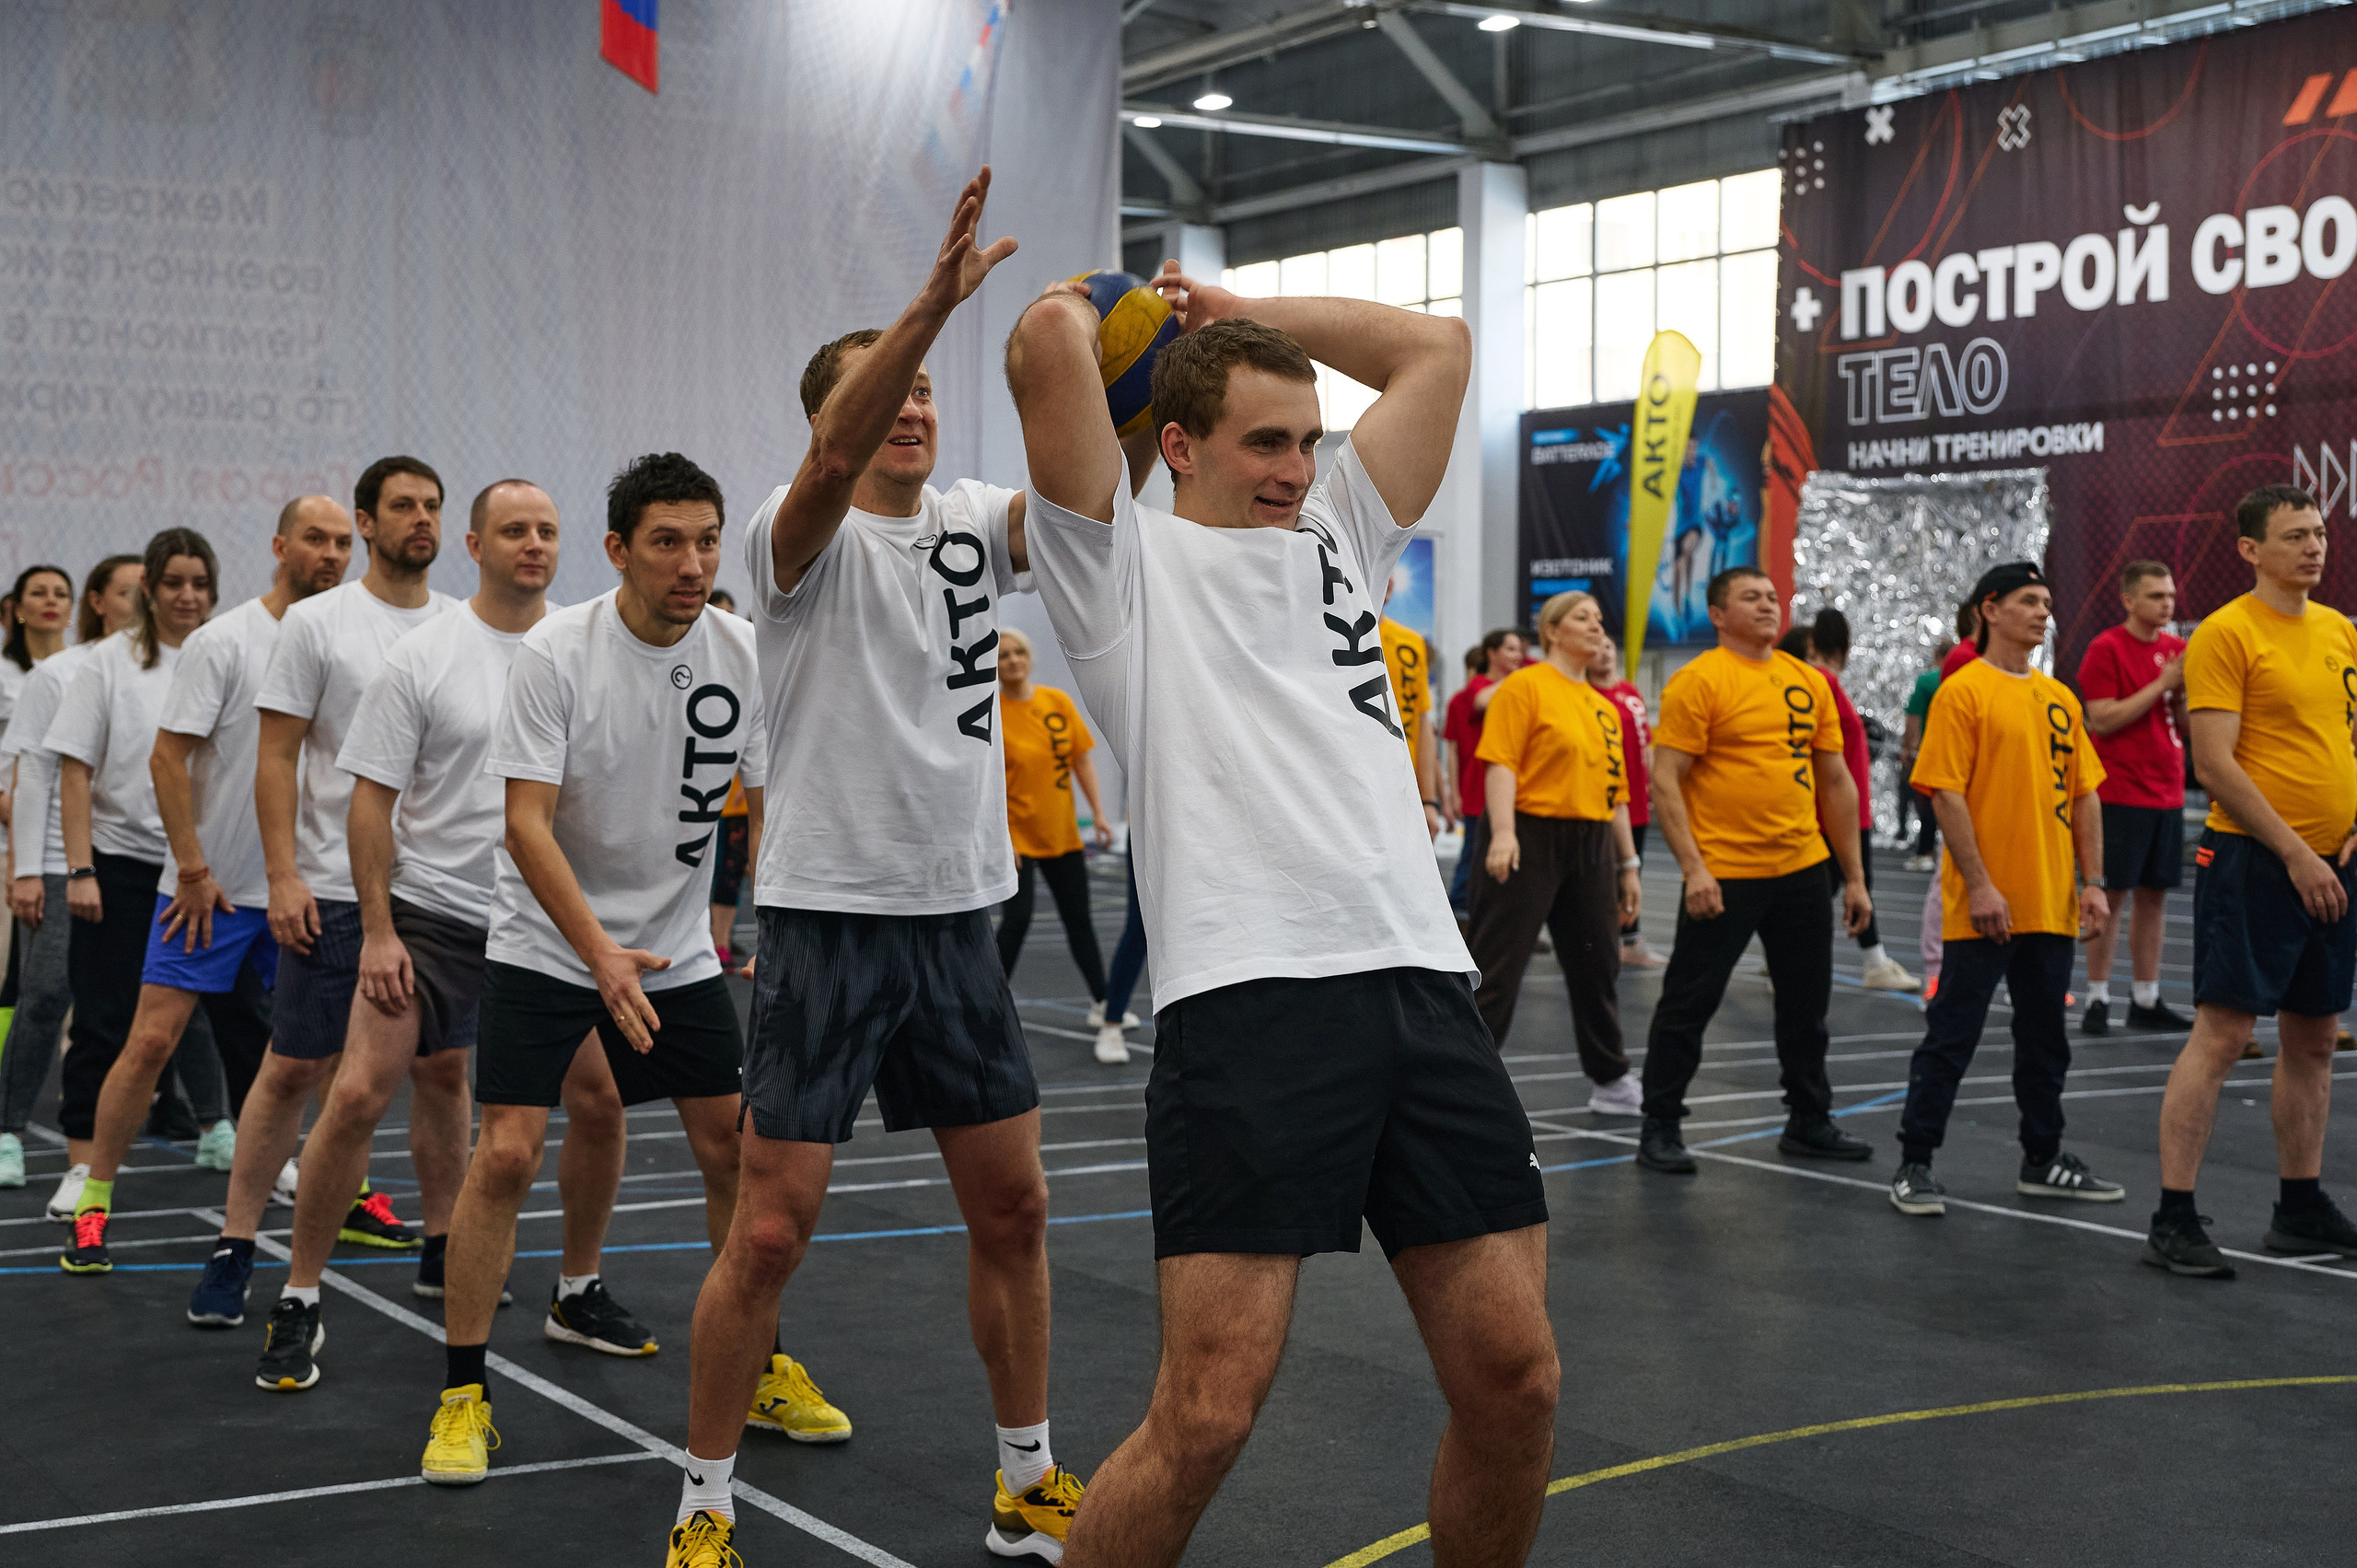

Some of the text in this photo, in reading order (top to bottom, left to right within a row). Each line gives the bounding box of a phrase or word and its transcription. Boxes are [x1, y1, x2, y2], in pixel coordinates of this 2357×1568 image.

[1840, 194, 2357, 341] ПОСТРОЙ СВО
[1642, 373, 1672, 500] АКТО
[1838, 336, 2009, 426] ТЕЛО
[1847, 421, 2106, 470] НАЧНИ ТРЕНИРОВКИ
[929, 529, 999, 747] АКТО
[675, 683, 740, 868] АКТО
[1043, 712, 1071, 790] АКТО
[1784, 685, 1814, 791] АКТО
[2047, 703, 2073, 830] АКТО
